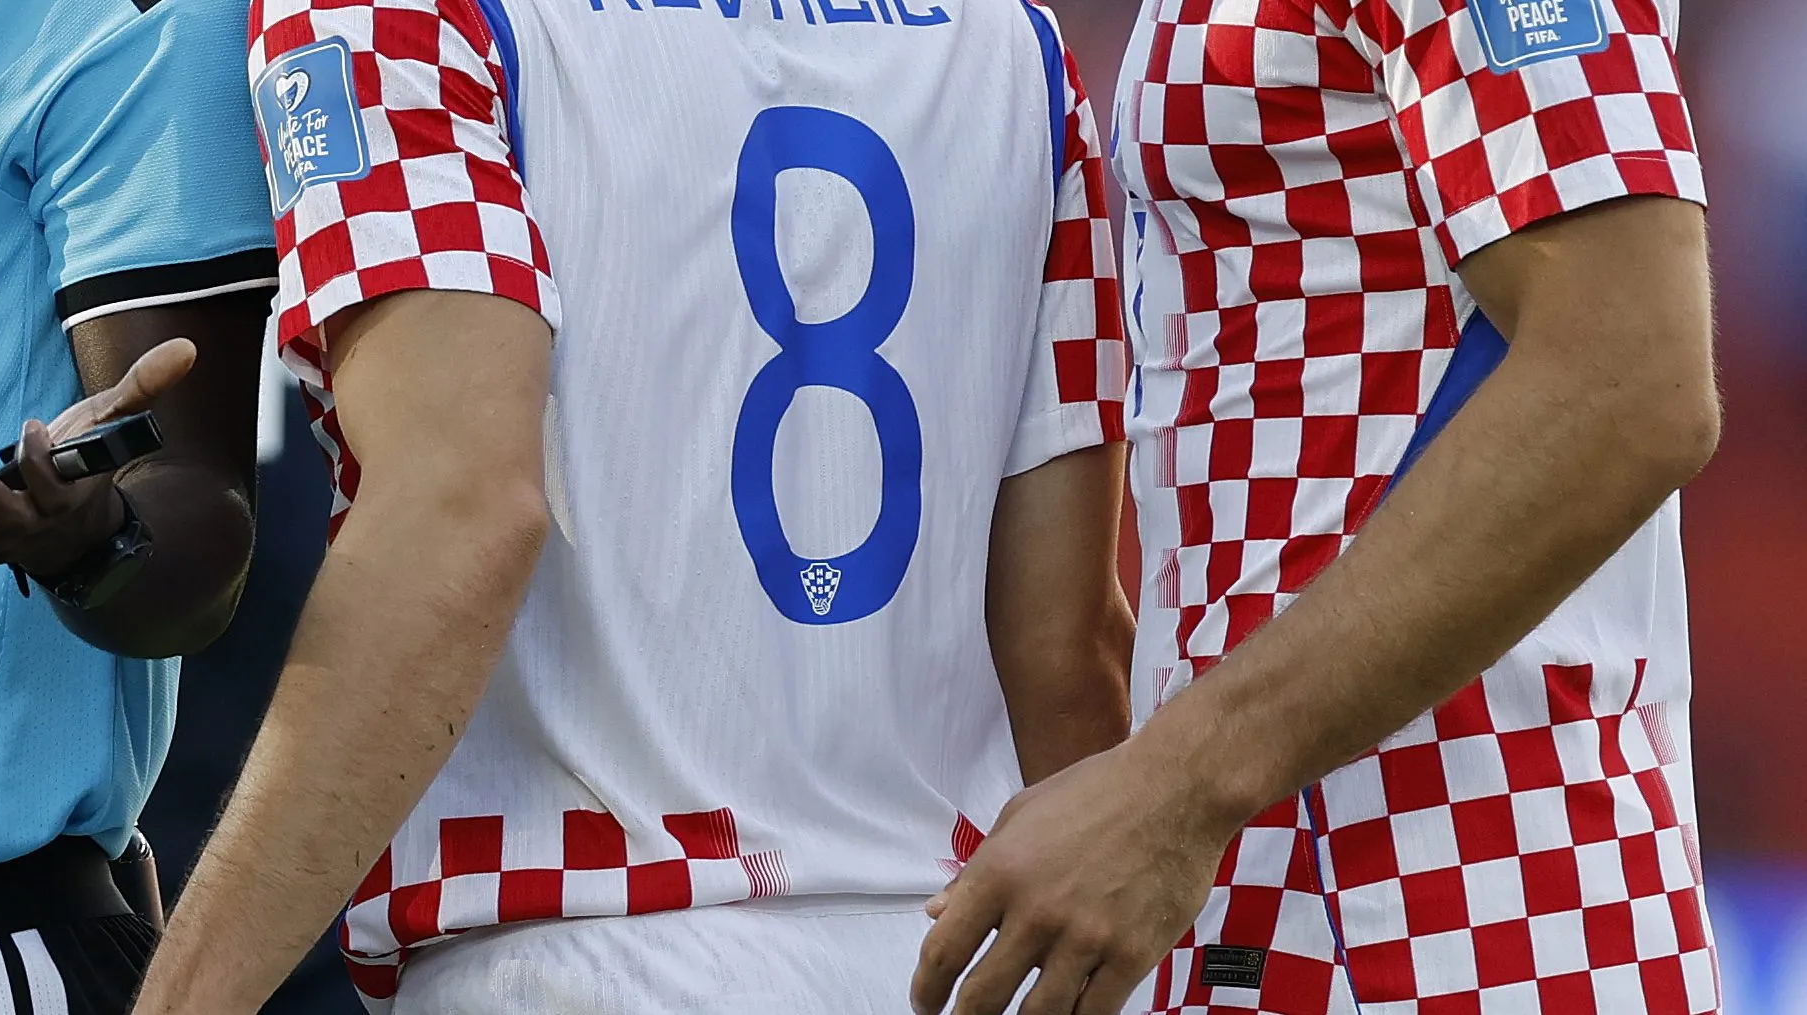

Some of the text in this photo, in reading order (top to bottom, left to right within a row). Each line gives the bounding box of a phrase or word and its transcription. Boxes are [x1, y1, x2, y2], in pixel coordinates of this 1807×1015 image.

[1525, 30, 1560, 46] FIFA
[277, 108, 329, 152] Ute For
[731, 105, 922, 625] 8
